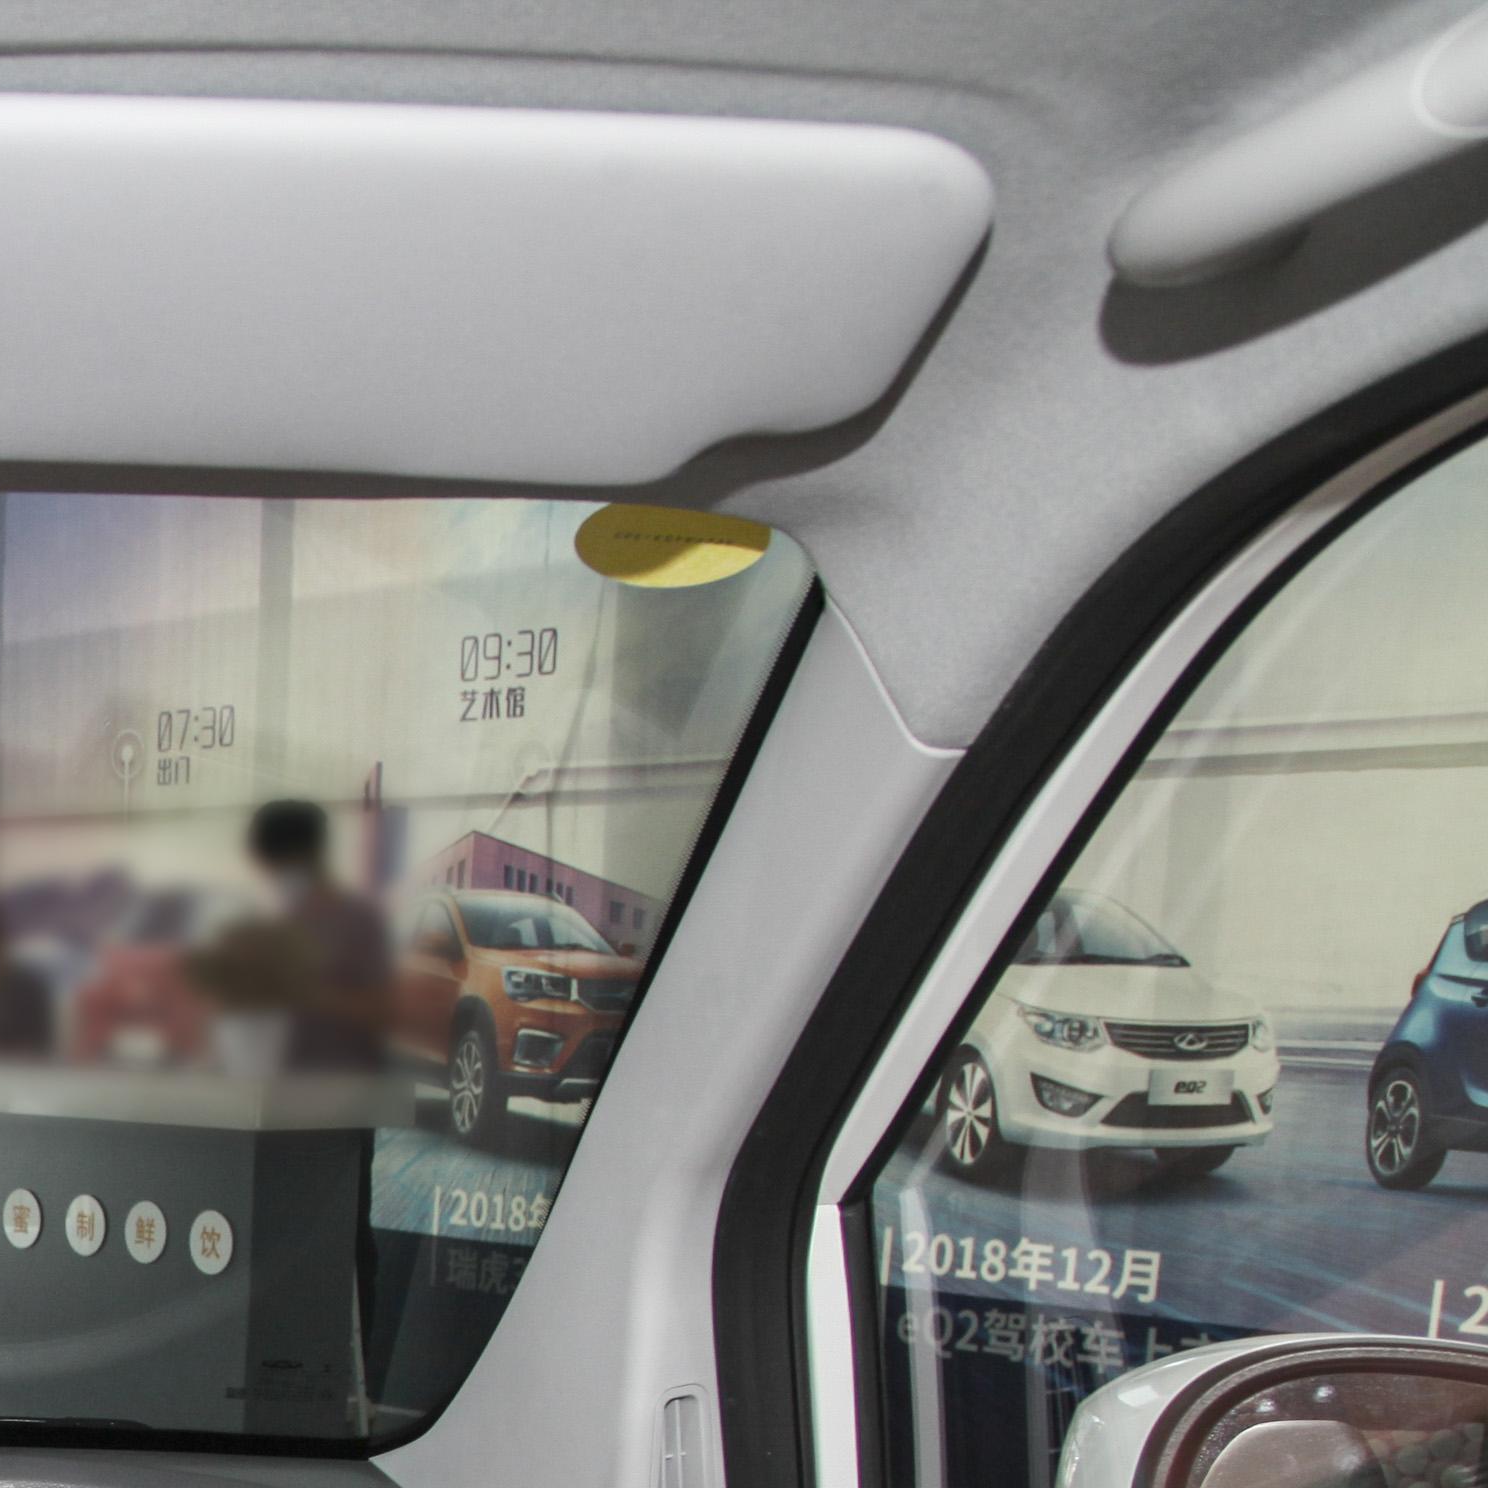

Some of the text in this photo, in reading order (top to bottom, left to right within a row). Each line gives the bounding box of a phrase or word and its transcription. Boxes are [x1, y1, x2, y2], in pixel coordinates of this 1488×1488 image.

[460, 628, 558, 682] 09:30
[458, 686, 525, 723] 艺术馆
[157, 705, 236, 752] 07:30
[157, 756, 191, 786] 出门
[901, 1232, 1162, 1304] 2018年12月
